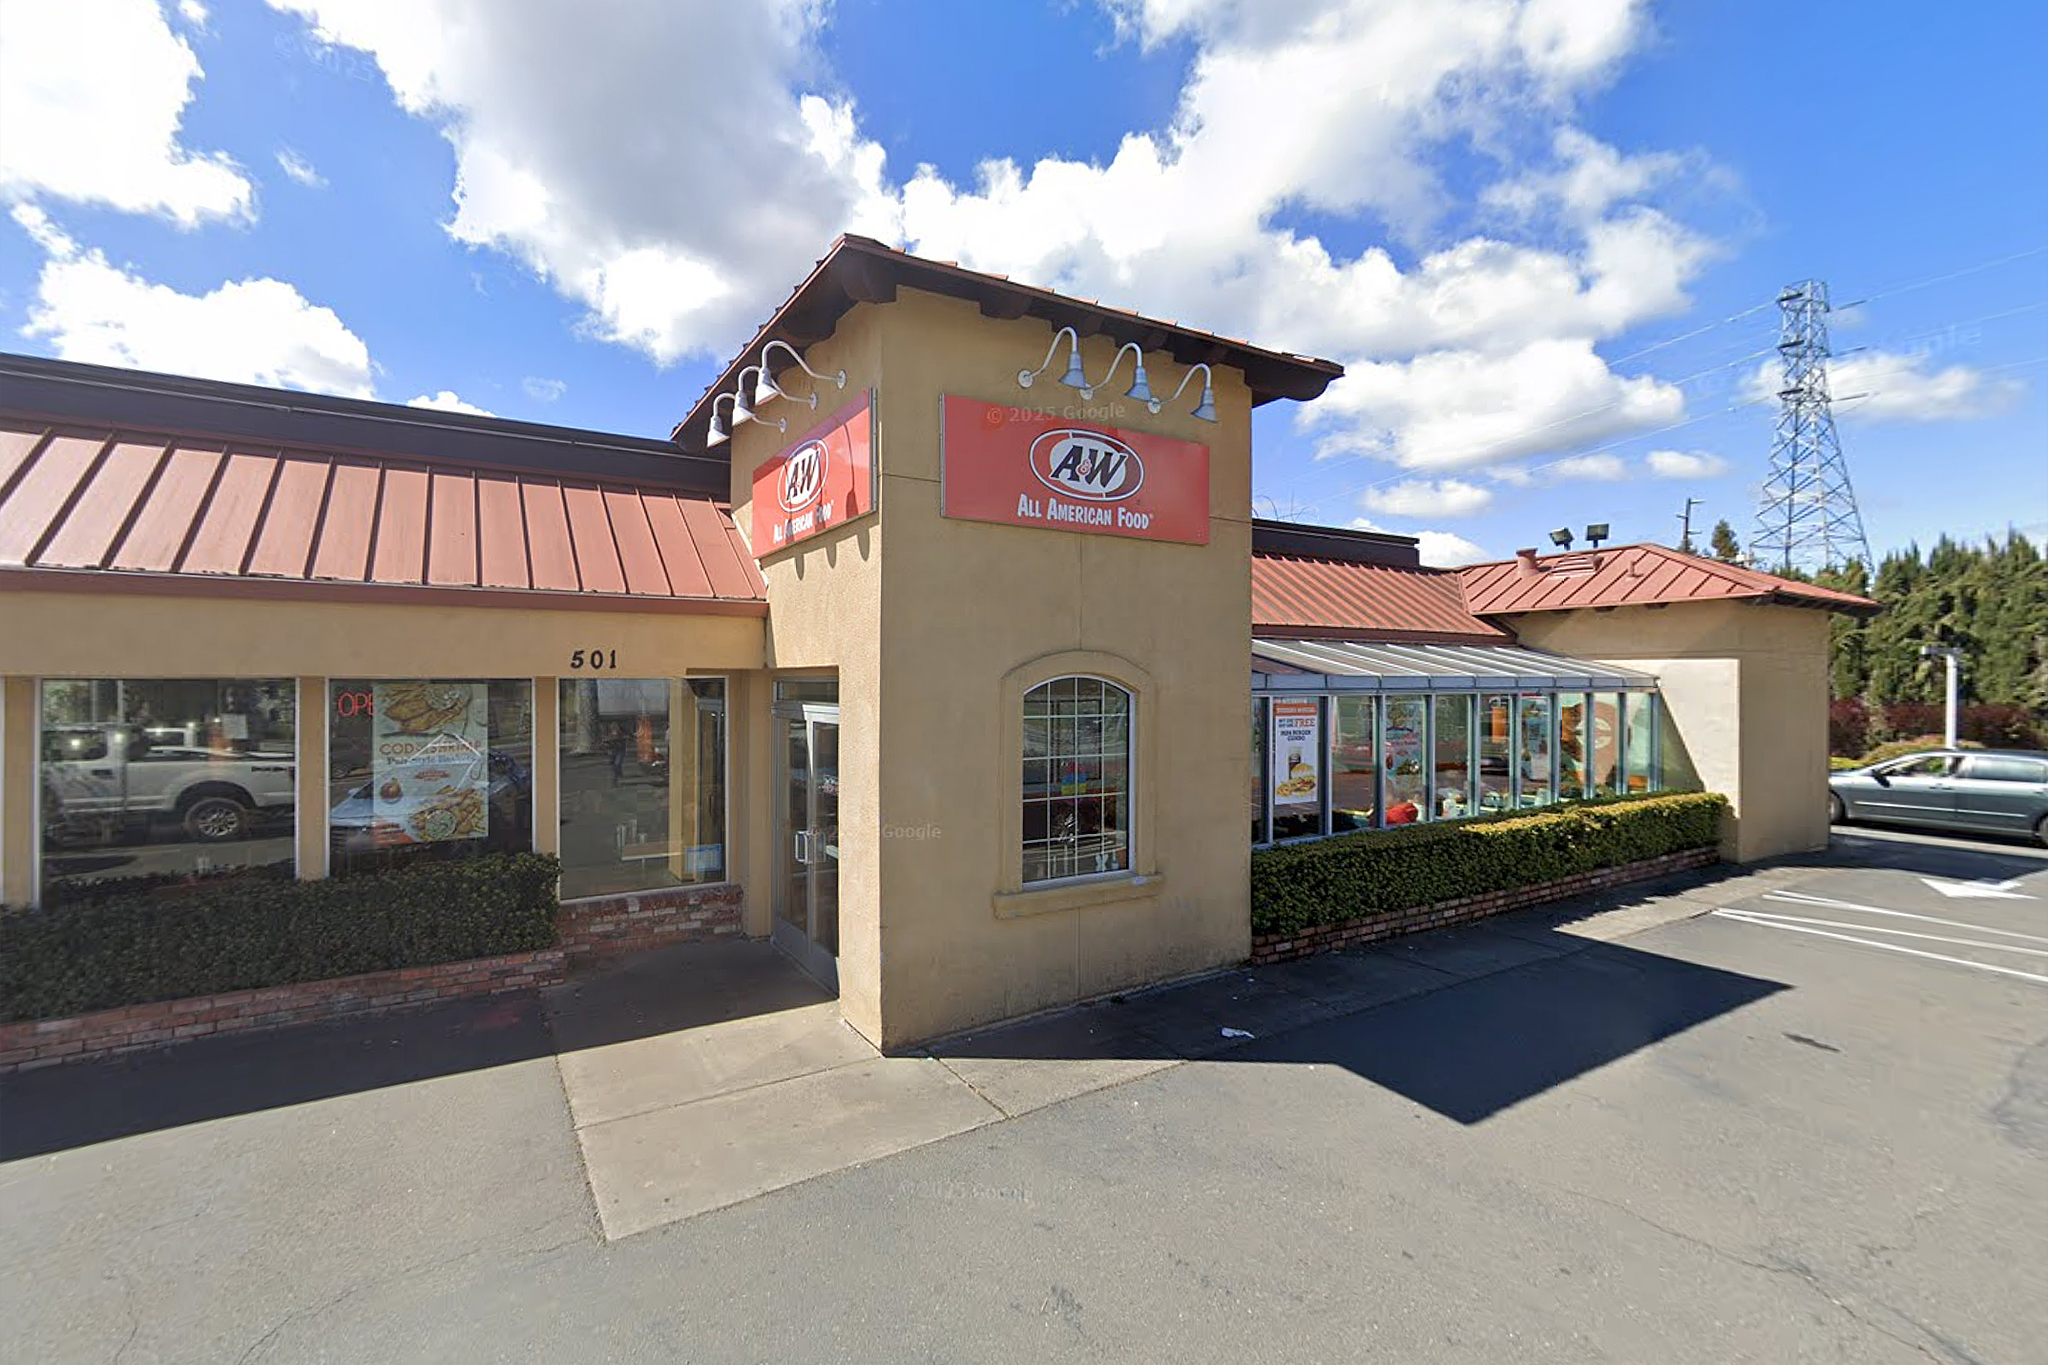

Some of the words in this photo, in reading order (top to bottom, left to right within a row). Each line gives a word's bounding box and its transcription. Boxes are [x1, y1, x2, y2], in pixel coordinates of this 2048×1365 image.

[1050, 444, 1127, 488] A&W
[570, 649, 617, 670] 501
[338, 692, 375, 718] OPE
[379, 743, 415, 756] COD
